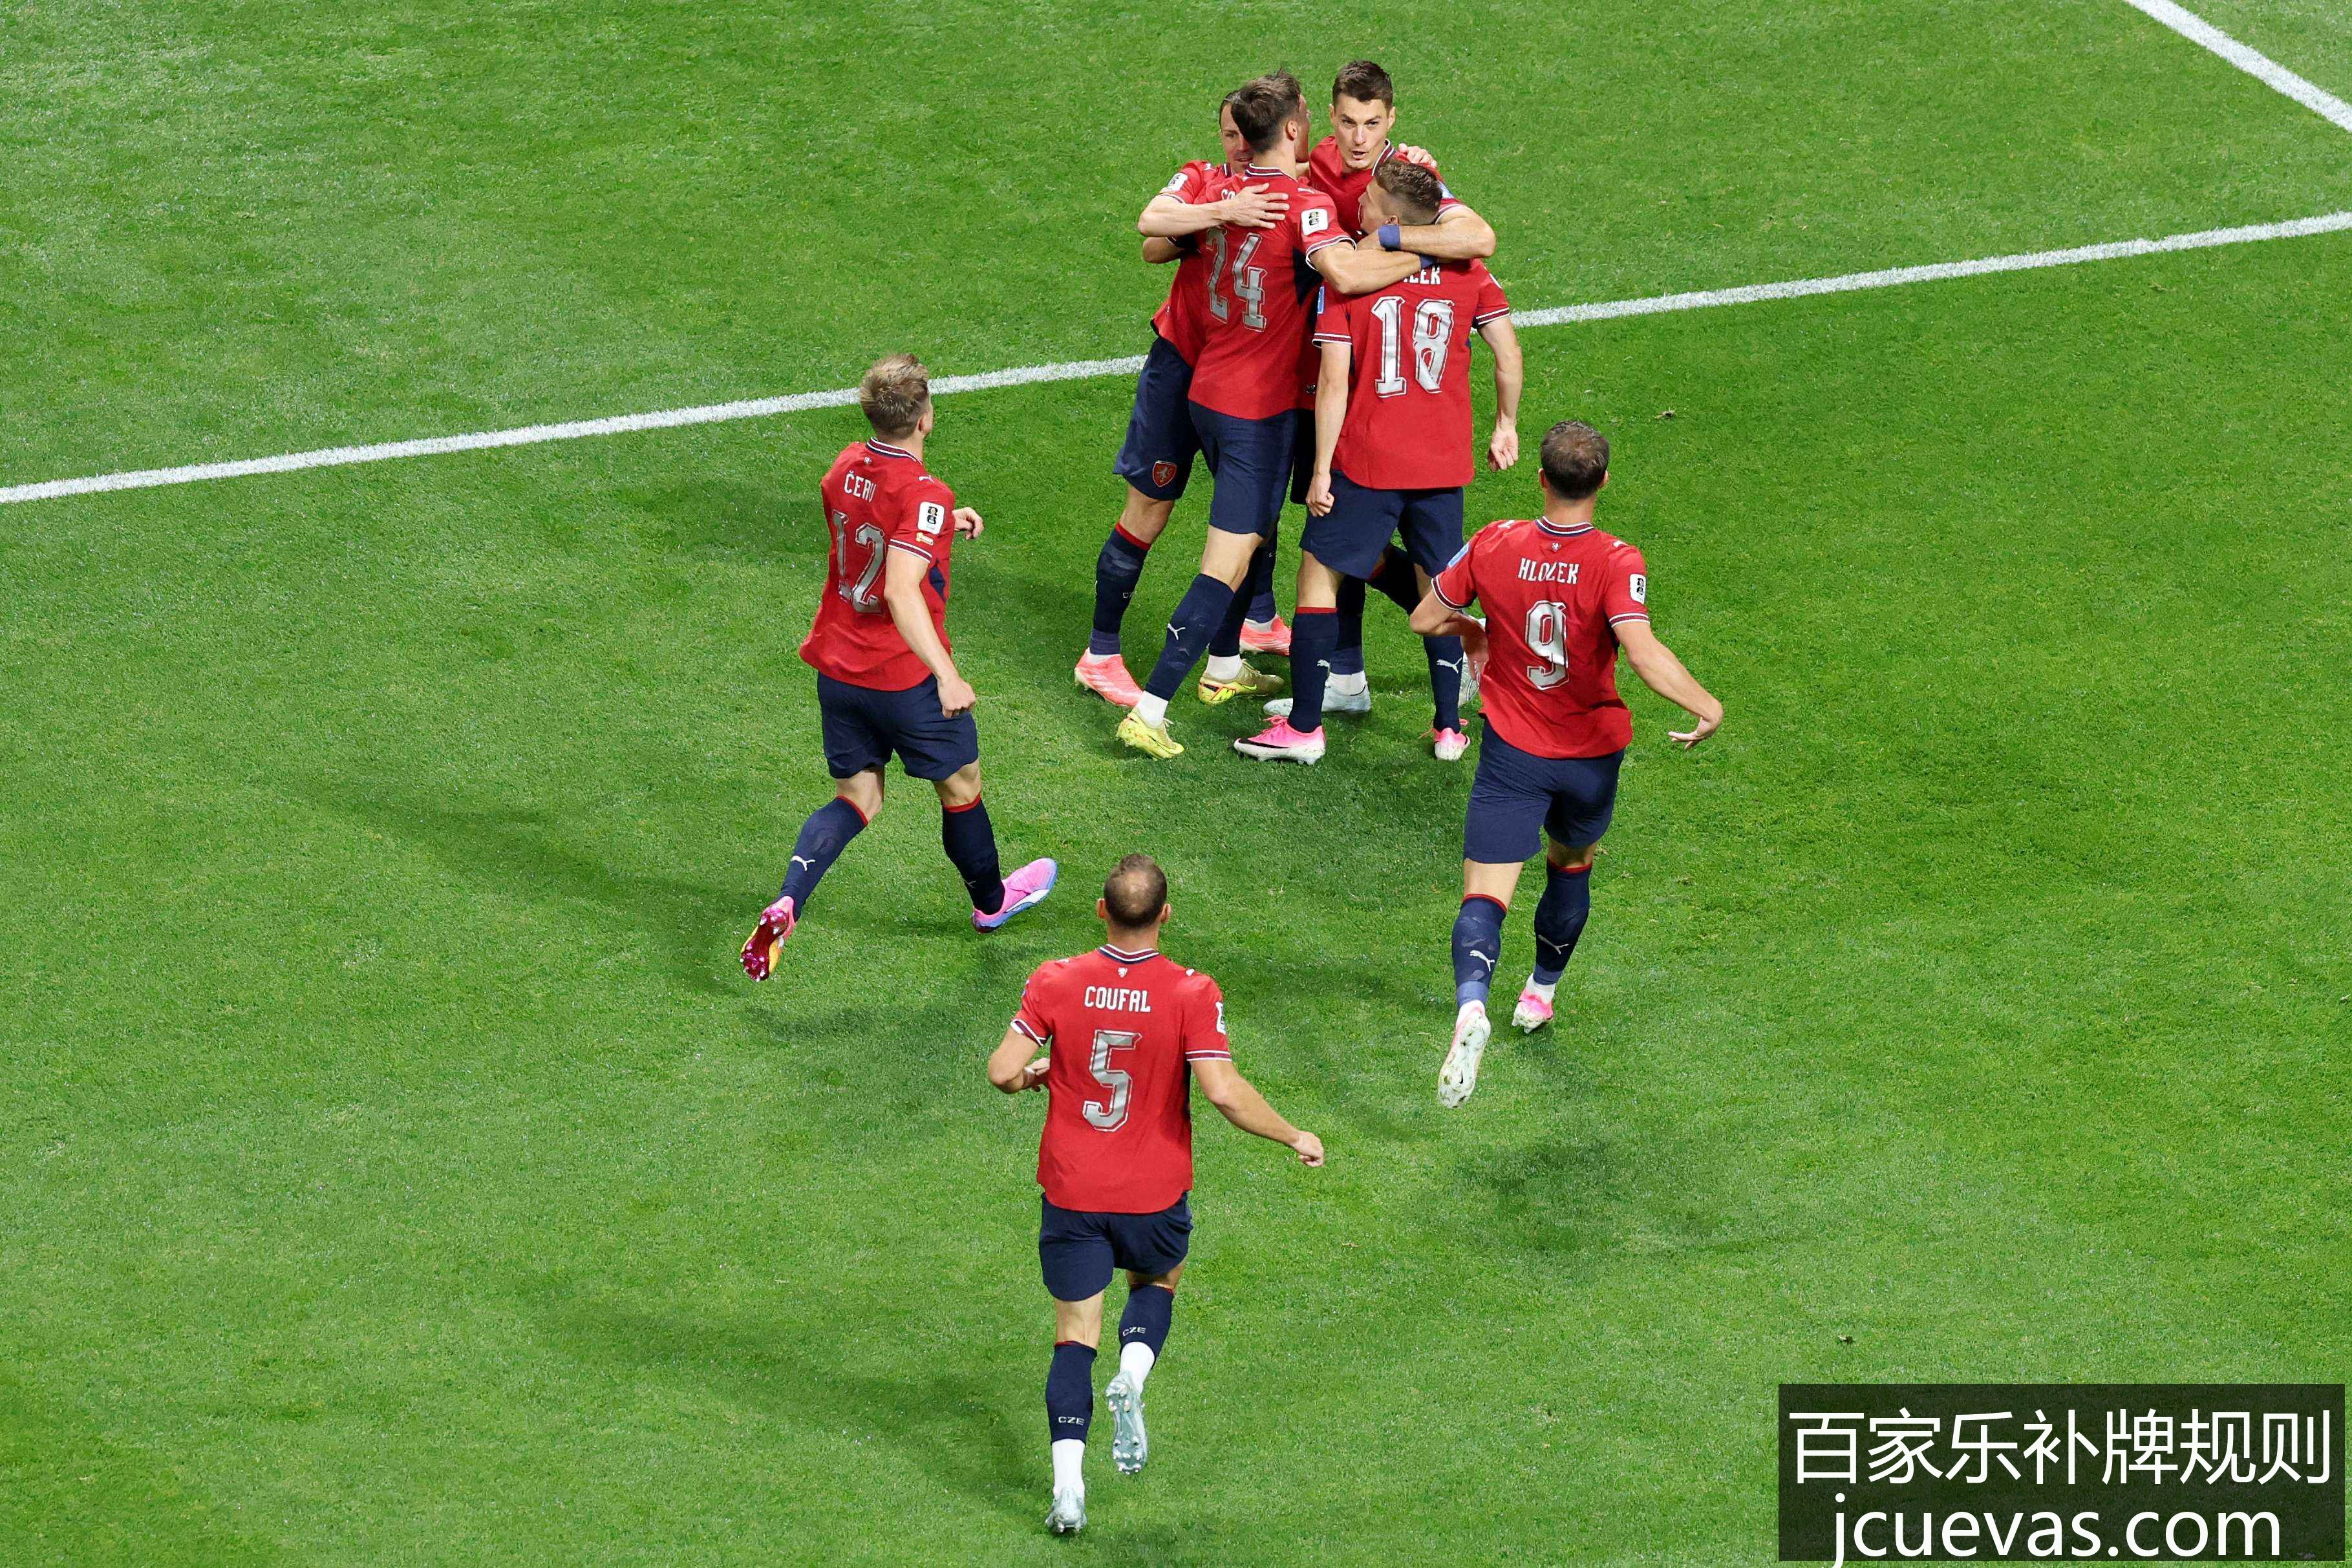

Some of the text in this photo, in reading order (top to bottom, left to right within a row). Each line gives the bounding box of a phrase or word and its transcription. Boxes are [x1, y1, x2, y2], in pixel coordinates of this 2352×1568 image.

[1206, 226, 1268, 333] 24
[1403, 265, 1440, 284] LEK
[1371, 295, 1455, 398] 18
[832, 509, 886, 618] 12
[1525, 600, 1569, 691] 9
[1084, 986, 1151, 1013] COUFAL
[1082, 1029, 1143, 1132] 5
[1122, 1326, 1146, 1337] CZE
[1058, 1416, 1085, 1426] CZE
